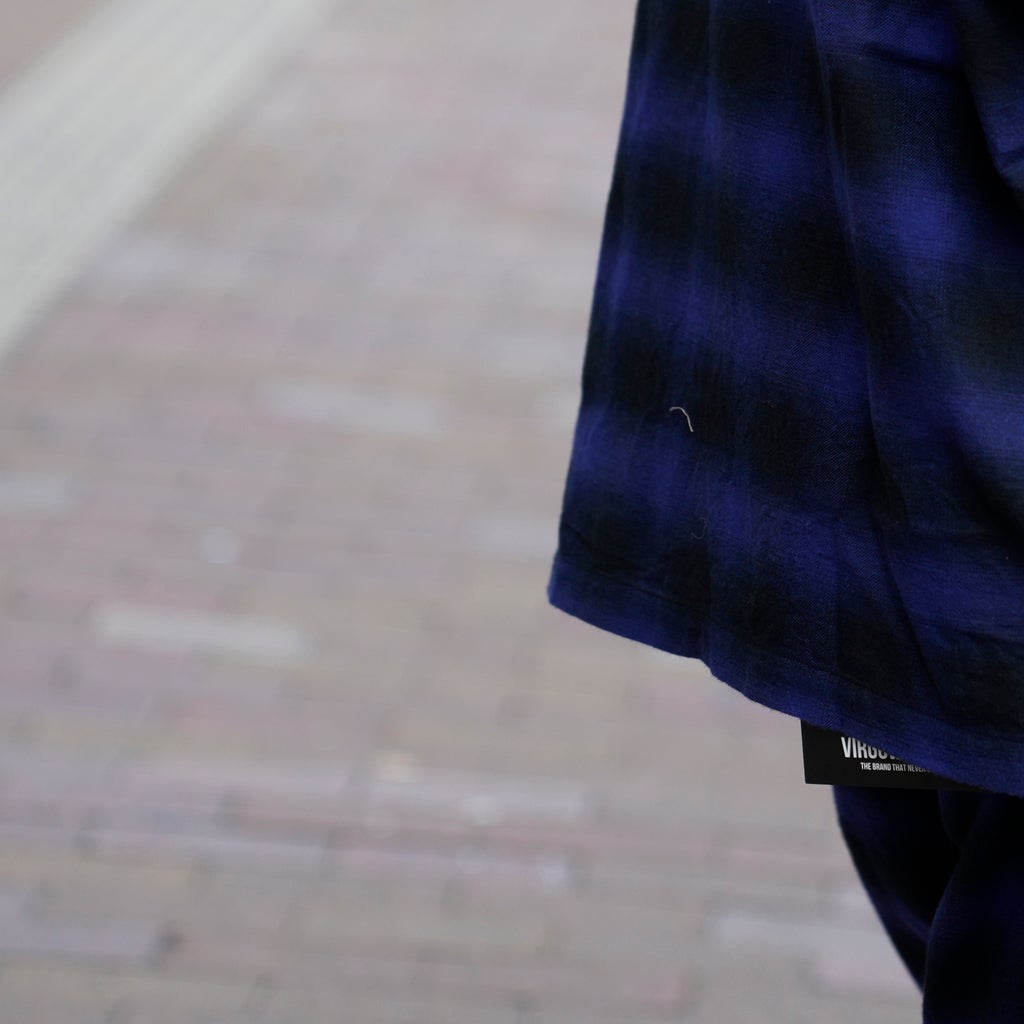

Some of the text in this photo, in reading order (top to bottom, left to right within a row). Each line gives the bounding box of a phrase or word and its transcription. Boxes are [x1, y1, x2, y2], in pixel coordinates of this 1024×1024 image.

[840, 736, 900, 760] VIRG
[860, 762, 872, 771] THE
[872, 762, 892, 772] BRAND
[892, 763, 906, 772] THAT
